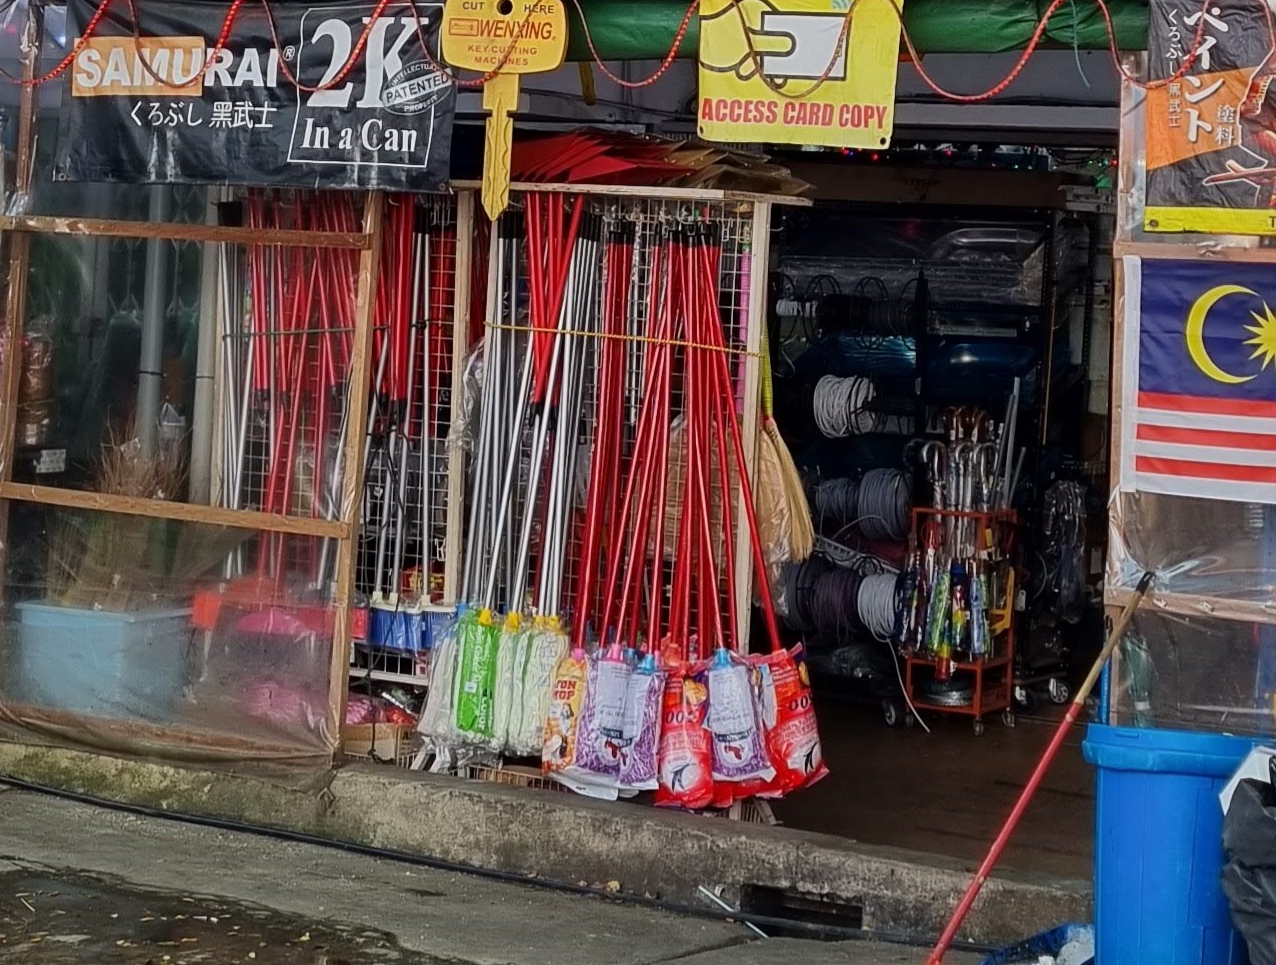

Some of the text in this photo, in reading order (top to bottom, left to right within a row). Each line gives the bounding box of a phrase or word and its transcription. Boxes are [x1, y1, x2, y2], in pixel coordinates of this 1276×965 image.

[463, 1, 555, 15] CUT HERE
[307, 17, 429, 108] 2K
[468, 44, 489, 53] KEY
[474, 56, 529, 66] MACHNES
[76, 46, 279, 88] SAMURAI
[1183, 6, 1229, 143] ペイント
[386, 71, 451, 104] PATENTED
[130, 101, 204, 127] くろぶし
[702, 98, 888, 129] ACCESS CARD COPY
[300, 118, 417, 153] In a Can
